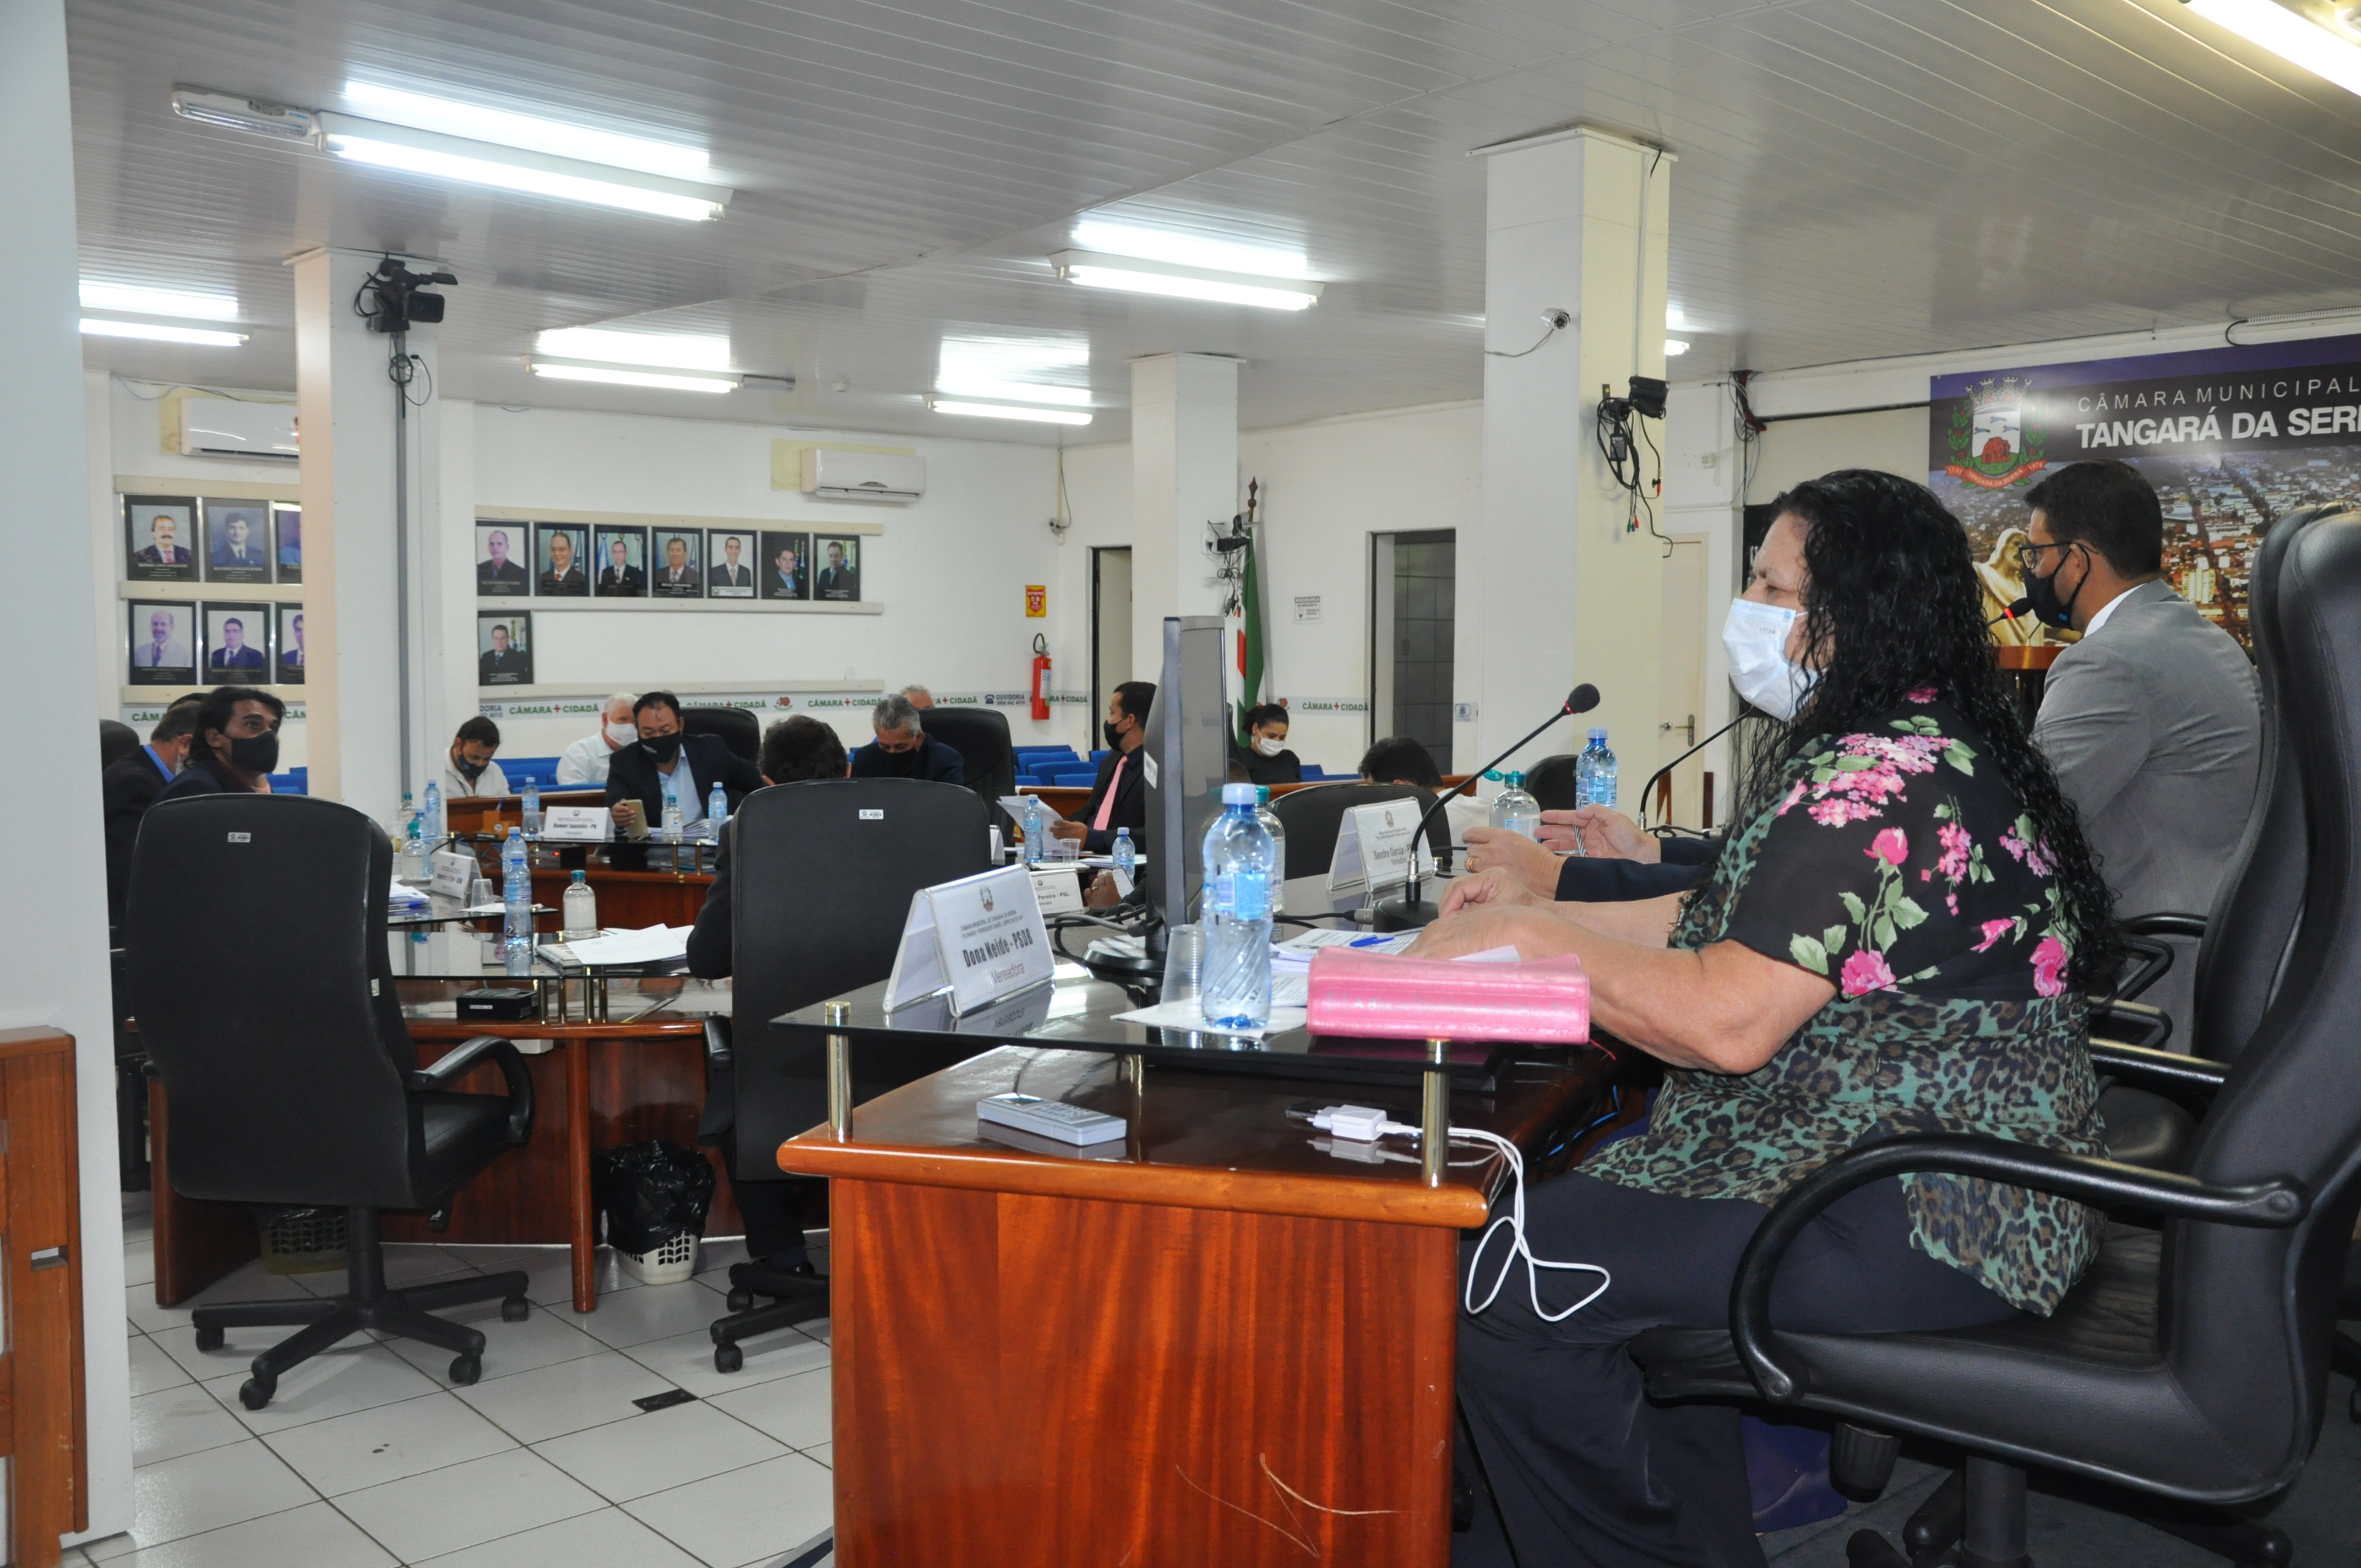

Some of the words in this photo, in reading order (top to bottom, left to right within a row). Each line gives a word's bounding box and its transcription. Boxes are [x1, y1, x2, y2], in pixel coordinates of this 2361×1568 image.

[2078, 390, 2186, 412] CÂMARA
[2196, 377, 2360, 402] MUNICIPAL
[2076, 406, 2222, 448] TANGARÁ
[2232, 411, 2278, 439] DA
[2287, 405, 2361, 436] SER
[734, 700, 766, 709] CIDADÃ
[808, 698, 843, 707] CÂMARA
[949, 696, 977, 704] CIDADÃ
[1302, 701, 1333, 710] CÂMARA
[1341, 703, 1369, 711] CIDADÃ
[509, 705, 552, 715] CÂMARA
[563, 703, 599, 713] CIDADÃ
[1373, 849, 1390, 860] Sandra
[1390, 846, 1405, 856] Garcia
[962, 946, 987, 968] Dona
[984, 937, 1010, 960] Neide
[1012, 928, 1033, 950] PSDB
[991, 963, 1025, 984] Vereadora
